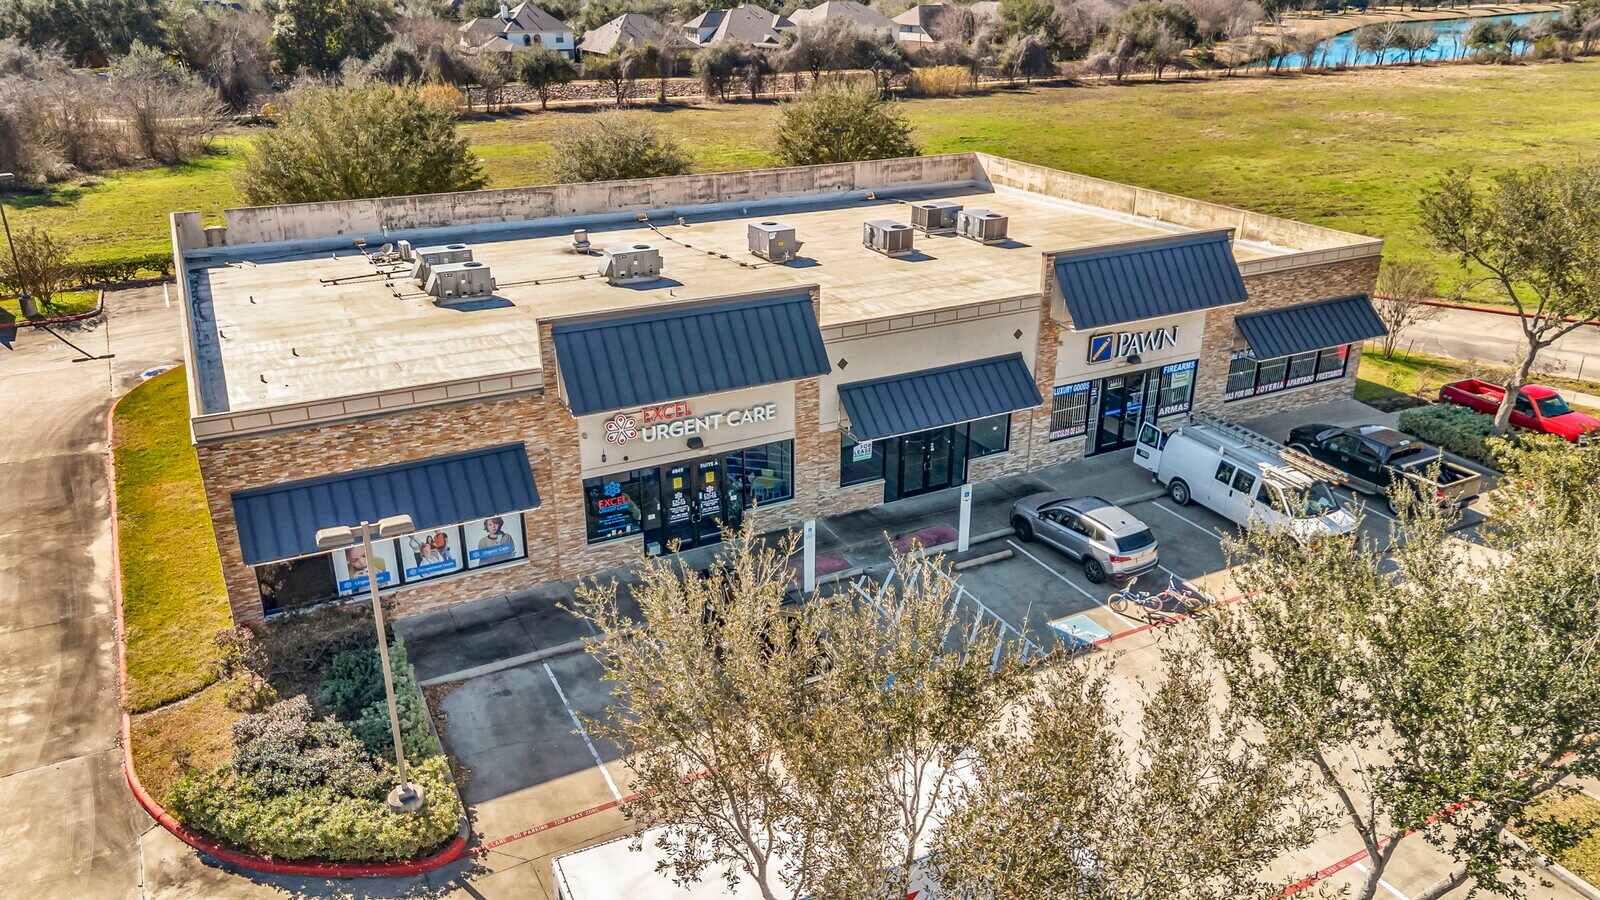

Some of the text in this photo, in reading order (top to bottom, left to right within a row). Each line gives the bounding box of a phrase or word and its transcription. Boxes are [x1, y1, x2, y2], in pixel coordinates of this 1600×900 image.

[1117, 326, 1179, 359] PAWN
[1163, 361, 1195, 374] FIREARMS
[1054, 381, 1090, 396] LUXURY GOODS
[1256, 381, 1285, 394] JOYERIA
[642, 402, 692, 424] EXCEL
[1158, 402, 1189, 416] ARMAS
[642, 404, 777, 443] URGENT CARE
[854, 447, 871, 455] LEASE
[700, 461, 714, 469] SUITE
[598, 496, 627, 508] EXCEL
[523, 824, 549, 836] PARKING
[567, 812, 584, 822] AWAY
